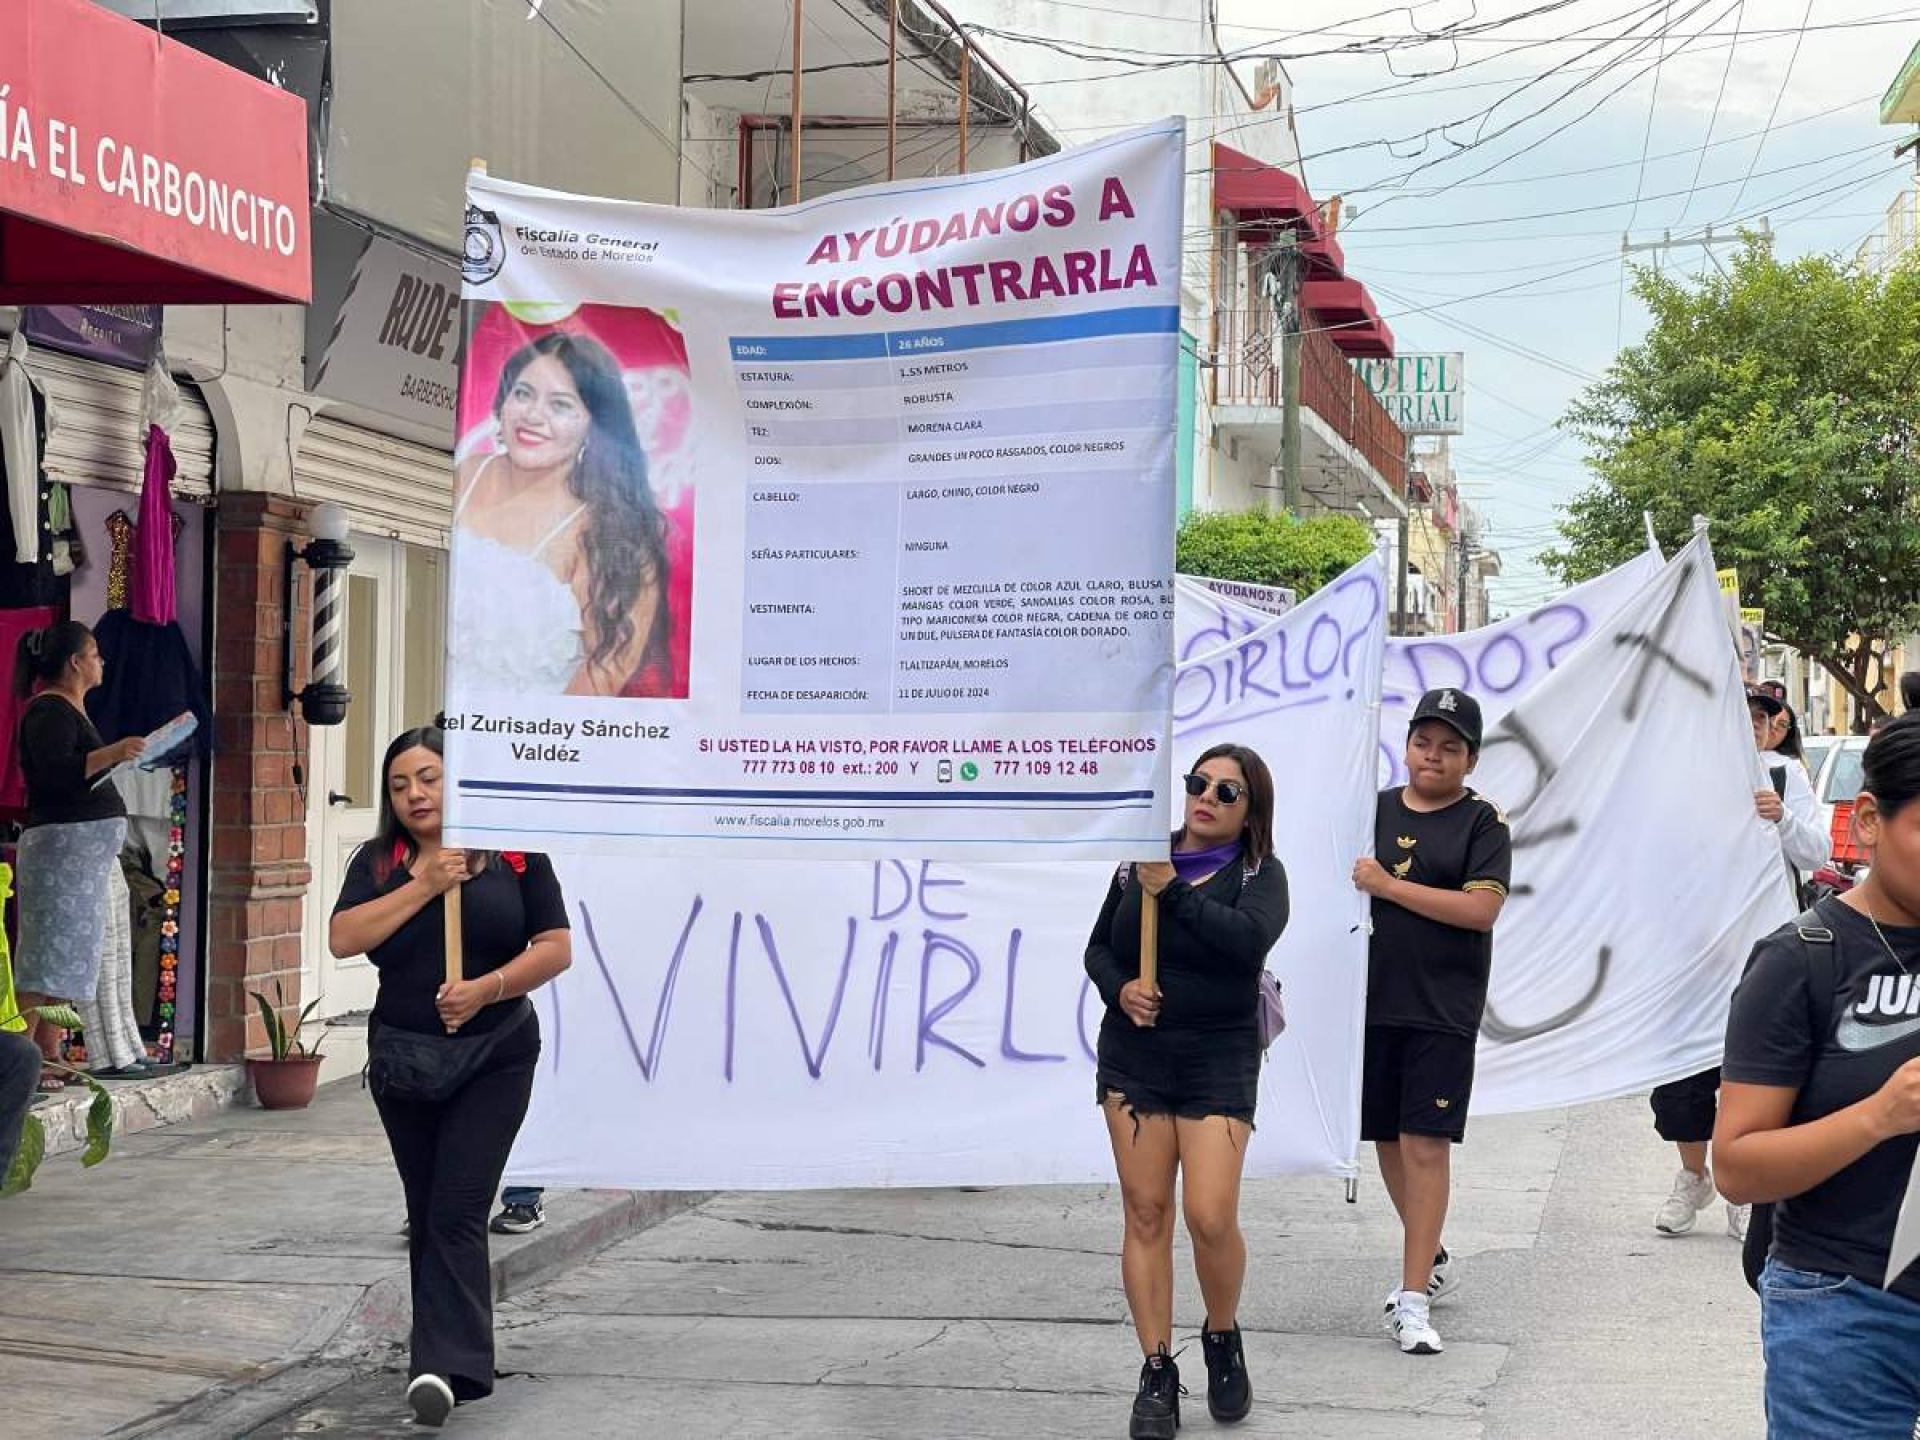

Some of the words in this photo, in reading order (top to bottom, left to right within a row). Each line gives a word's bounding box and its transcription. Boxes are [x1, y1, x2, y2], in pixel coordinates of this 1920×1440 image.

[49, 119, 85, 184] EL
[97, 136, 296, 255] CARBONCITO
[806, 185, 1075, 265] AYÚDANOS
[1098, 177, 1135, 221] A
[586, 233, 659, 251] General
[582, 248, 597, 260] de
[602, 250, 654, 263] Morelos
[772, 244, 1157, 320] ENCONTRARLA
[379, 273, 460, 361] RUDE
[914, 336, 945, 348] AÑOS
[736, 345, 767, 356] EDAD:
[741, 372, 794, 382] ESTATURA:
[900, 367, 923, 379] 1.55
[924, 362, 969, 376] METROS
[747, 398, 814, 410] COMPLEXIÓN:
[903, 391, 953, 404] ROBUSTA
[908, 422, 952, 433] MORENA
[954, 420, 983, 431] CLARA
[908, 452, 952, 463] GRANDES
[954, 451, 968, 461] UN
[969, 449, 994, 459] POCO
[996, 447, 1048, 459] RASGADOS,
[1049, 444, 1081, 455] COLOR
[1083, 441, 1125, 452] NEGROS
[754, 456, 782, 465] OJOS:
[753, 492, 801, 502] CABELLO:
[907, 489, 940, 500] LARGO,
[941, 487, 974, 498] CHINO,
[975, 485, 1006, 496] COLOR
[1007, 483, 1040, 494] NEGRO
[904, 541, 949, 551] NINGUNA
[751, 548, 783, 560] SEÑAS
[785, 550, 860, 560] PARTICULARES:
[901, 586, 934, 596] SHORT
[937, 585, 949, 595] DE
[1004, 583, 1017, 593] DE
[1020, 582, 1052, 592] COLOR
[1056, 581, 1082, 591] AZUL
[1086, 580, 1124, 591] CLARO,
[1128, 580, 1163, 590] BLUSA
[902, 601, 944, 610] MANGAS
[948, 600, 979, 609] COLOR
[983, 598, 1015, 609] VERDE,
[1020, 596, 1075, 607] SANDALIAS
[1079, 596, 1116, 606] COLOR
[1120, 595, 1155, 605] ROSA,
[1278, 592, 1287, 604] A
[750, 604, 816, 614] VESTIMENTA:
[901, 615, 923, 625] TIPO
[926, 614, 988, 625] MARICONERA
[991, 613, 1024, 623] COLOR
[1026, 612, 1063, 622] NEGRA,
[1066, 612, 1111, 622] CADENA
[1114, 611, 1129, 620] DE
[1133, 610, 1159, 620] ORO
[900, 631, 916, 640] UN
[916, 631, 939, 641] DUE,
[940, 629, 980, 639] PULSERA
[981, 629, 994, 639] DE
[996, 625, 1044, 639] FANTASÍA
[1044, 626, 1079, 637] COLOR
[1081, 626, 1131, 637] DORADO.
[748, 656, 782, 666] LUGAR
[784, 656, 798, 666] DE
[799, 656, 817, 666] LOS
[818, 656, 861, 666] HECHOS:
[899, 658, 962, 670] TLALTIZAPÁN,
[964, 658, 1009, 669] MORELOS
[747, 690, 779, 700] FECHA
[780, 690, 794, 700] DE
[796, 687, 870, 700] DESAPARICIÓN:
[898, 688, 910, 699] 11
[911, 688, 924, 698] DE
[924, 688, 951, 698] JULIO
[952, 688, 964, 698] DE
[967, 687, 989, 698] 2024
[471, 714, 576, 740] Zurisaday
[581, 719, 671, 739] Sánchez
[511, 743, 580, 762] Valdéz
[699, 739, 713, 753] SI
[718, 740, 770, 753] USTED
[772, 740, 791, 753] LA
[796, 741, 817, 753] HA
[819, 741, 867, 755] VISTO,
[869, 741, 899, 753] POR
[903, 740, 948, 753] FAVOR
[952, 740, 1001, 753] LLAME
[1007, 740, 1019, 753] A
[1022, 740, 1052, 753] LOS
[1058, 737, 1156, 753] TELÉFONOS
[742, 760, 767, 774] 777
[772, 760, 795, 774] 773
[799, 760, 815, 774] 08
[819, 760, 835, 774] 10
[842, 761, 871, 774] ext.:
[875, 761, 899, 775] 200
[909, 761, 919, 775] Y
[994, 761, 1020, 775] 777
[1025, 761, 1051, 775] 109
[1056, 761, 1074, 775] 12
[1079, 761, 1098, 775] 48
[871, 860, 968, 920] DE
